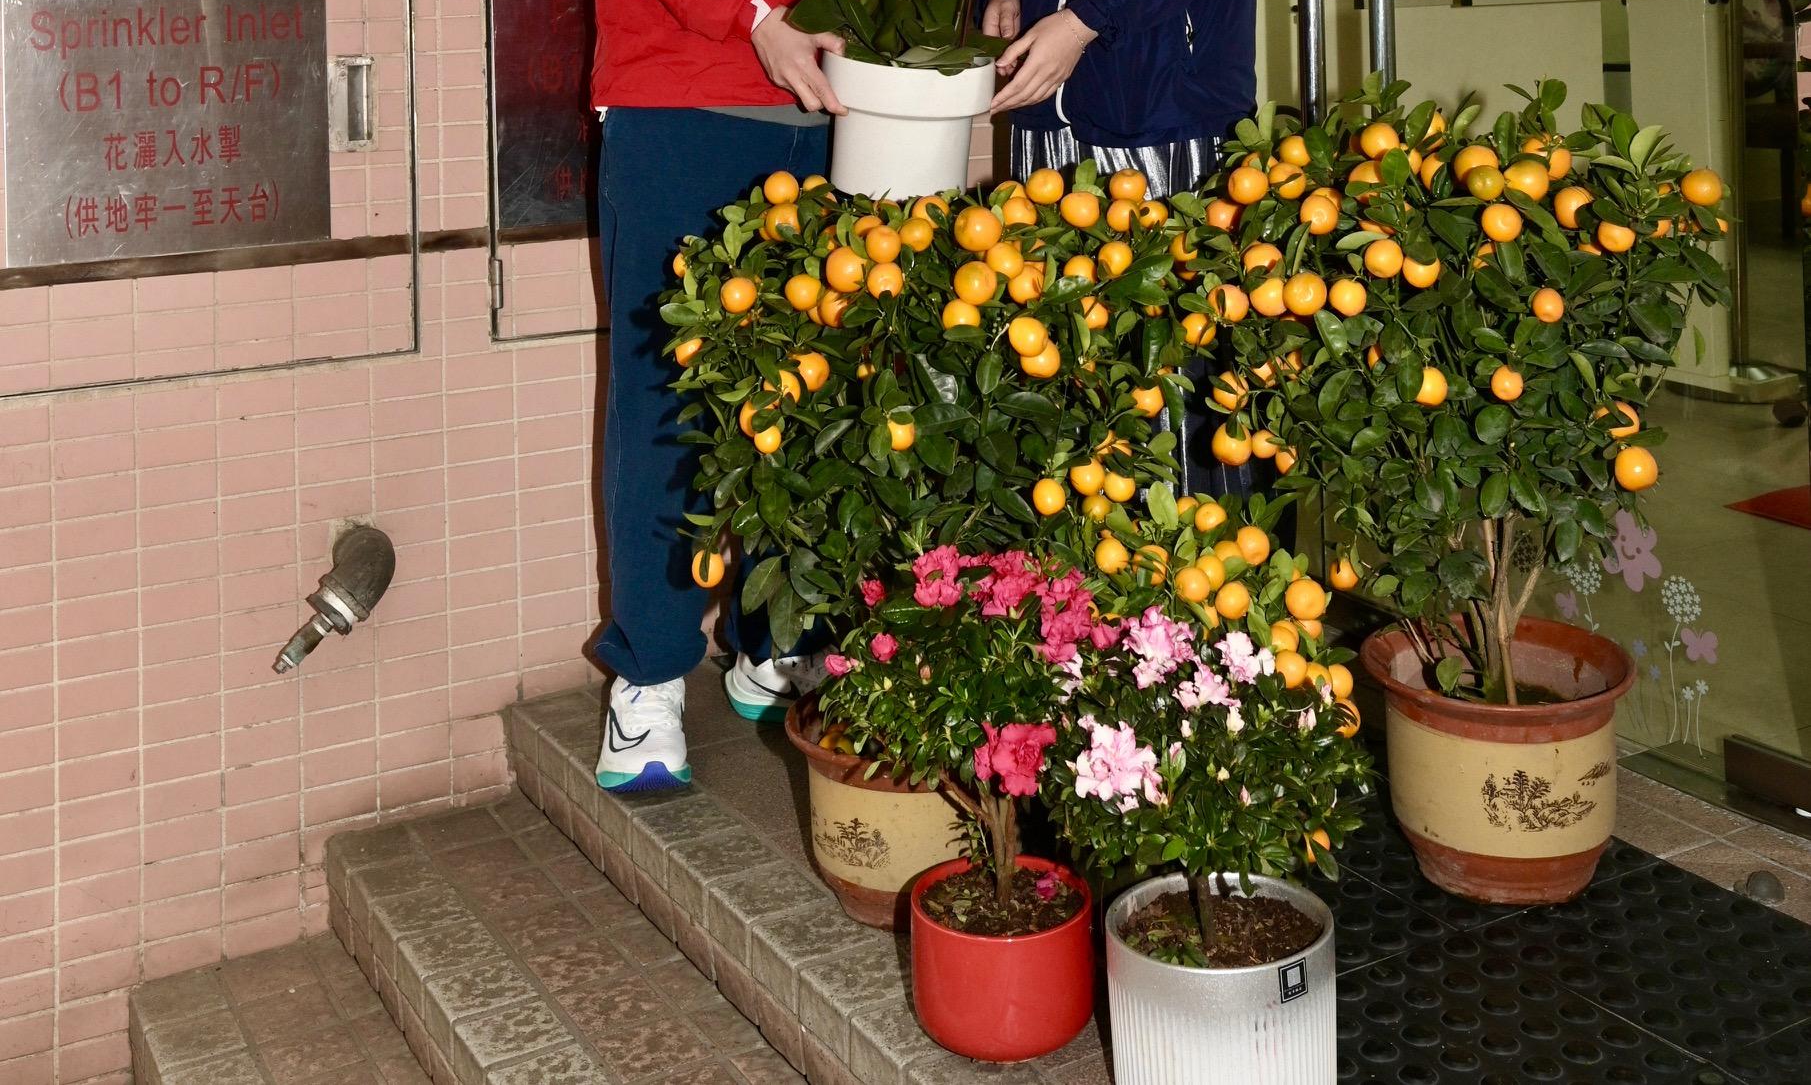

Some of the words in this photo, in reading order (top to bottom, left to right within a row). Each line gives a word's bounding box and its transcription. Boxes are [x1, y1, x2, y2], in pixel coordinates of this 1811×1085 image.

[30, 7, 207, 60] Sprinkler
[223, 1, 305, 44] Inlet
[59, 68, 123, 113] (B1
[146, 69, 183, 108] to
[199, 61, 282, 106] R/F)
[103, 123, 241, 172] 花灑入水掣
[65, 177, 280, 240] (供地牢一至天台)
